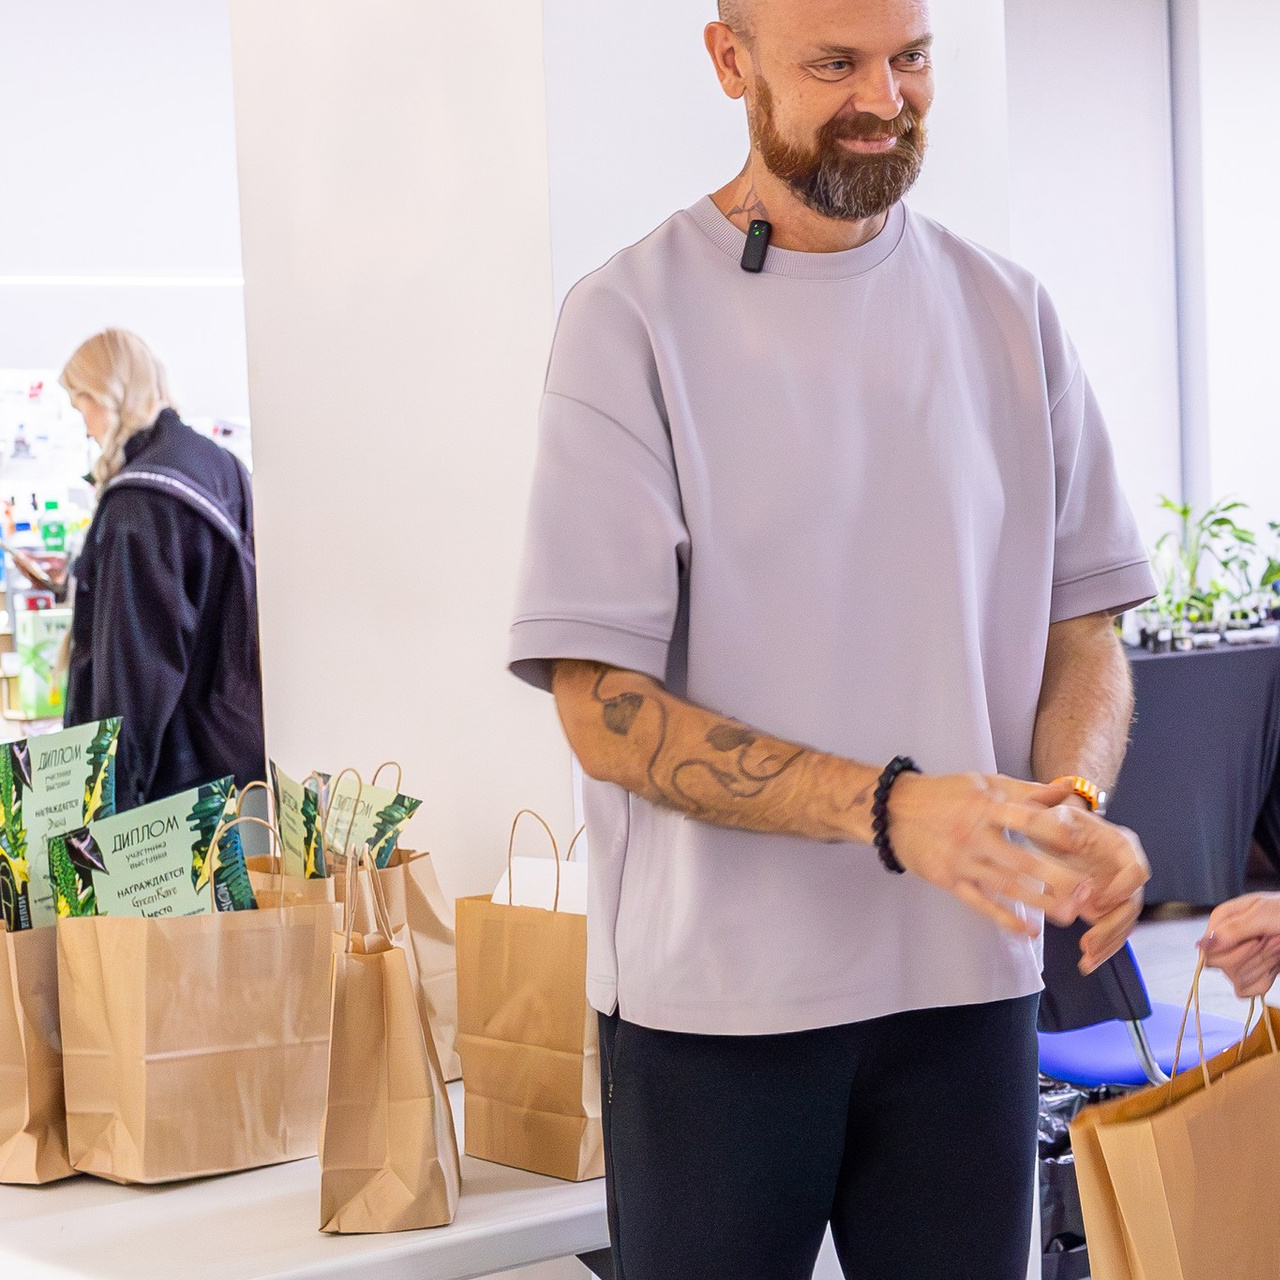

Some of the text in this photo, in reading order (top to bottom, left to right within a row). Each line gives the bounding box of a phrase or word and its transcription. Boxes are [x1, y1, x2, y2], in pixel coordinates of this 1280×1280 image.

[37, 743, 82, 771] ДИПЛОМ
[111, 815, 180, 854] ДИПЛОМ
[116, 866, 185, 899] НАГРАЖДАЕТСЯ
